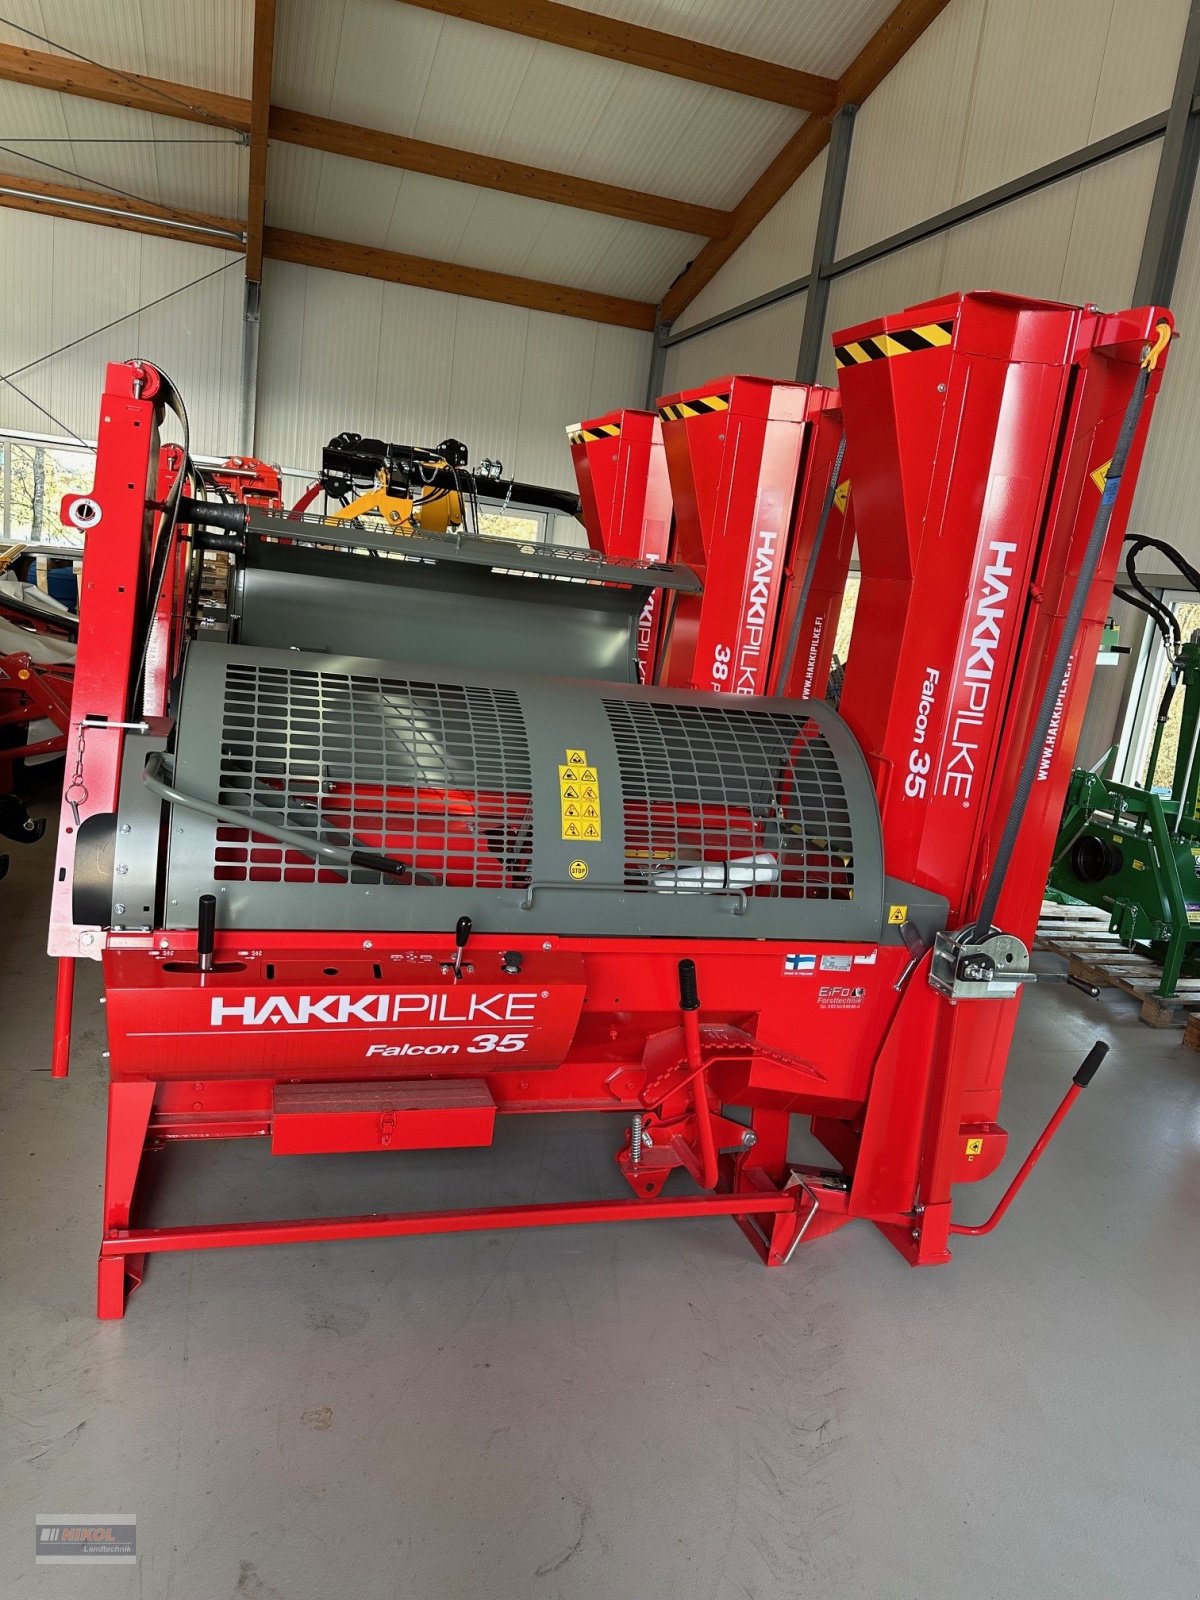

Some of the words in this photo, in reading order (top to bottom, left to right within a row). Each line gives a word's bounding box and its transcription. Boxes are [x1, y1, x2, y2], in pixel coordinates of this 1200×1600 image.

[712, 644, 731, 681] 38
[912, 666, 940, 743] Falcon
[904, 749, 931, 799] 35
[818, 986, 850, 997] EiFo
[210, 993, 538, 1026] HAKKIPILKE
[365, 1042, 460, 1057] Falcon
[466, 1033, 529, 1054] 35
